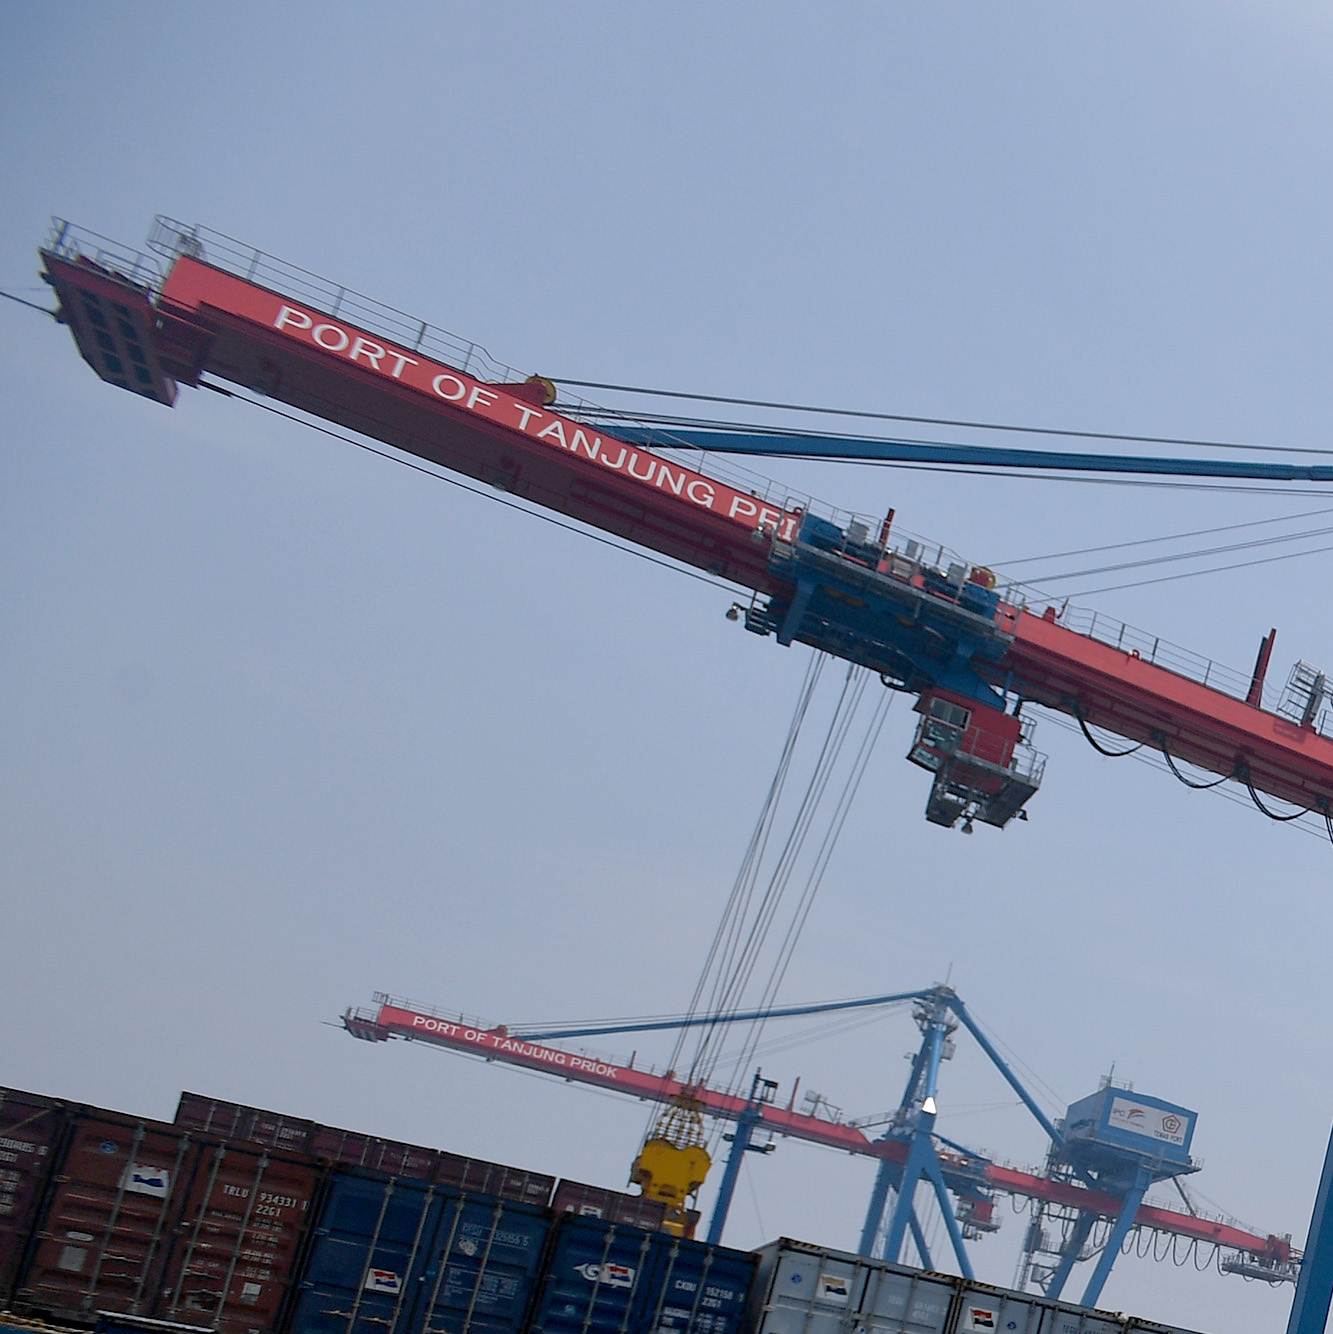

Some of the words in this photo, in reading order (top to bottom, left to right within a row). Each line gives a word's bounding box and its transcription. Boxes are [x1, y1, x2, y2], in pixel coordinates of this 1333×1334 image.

[274, 305, 419, 378] PORT
[432, 373, 498, 411] OF
[514, 402, 716, 508] TANJUNG
[728, 494, 800, 546] PRI
[413, 1015, 460, 1036] PORT
[464, 1029, 487, 1044] OF
[492, 1036, 567, 1065] TANJUNG
[570, 1058, 619, 1079] PRIOK
[223, 1184, 250, 1198] TRLU
[259, 1192, 297, 1208] 934331
[255, 1204, 281, 1217] 22G1
